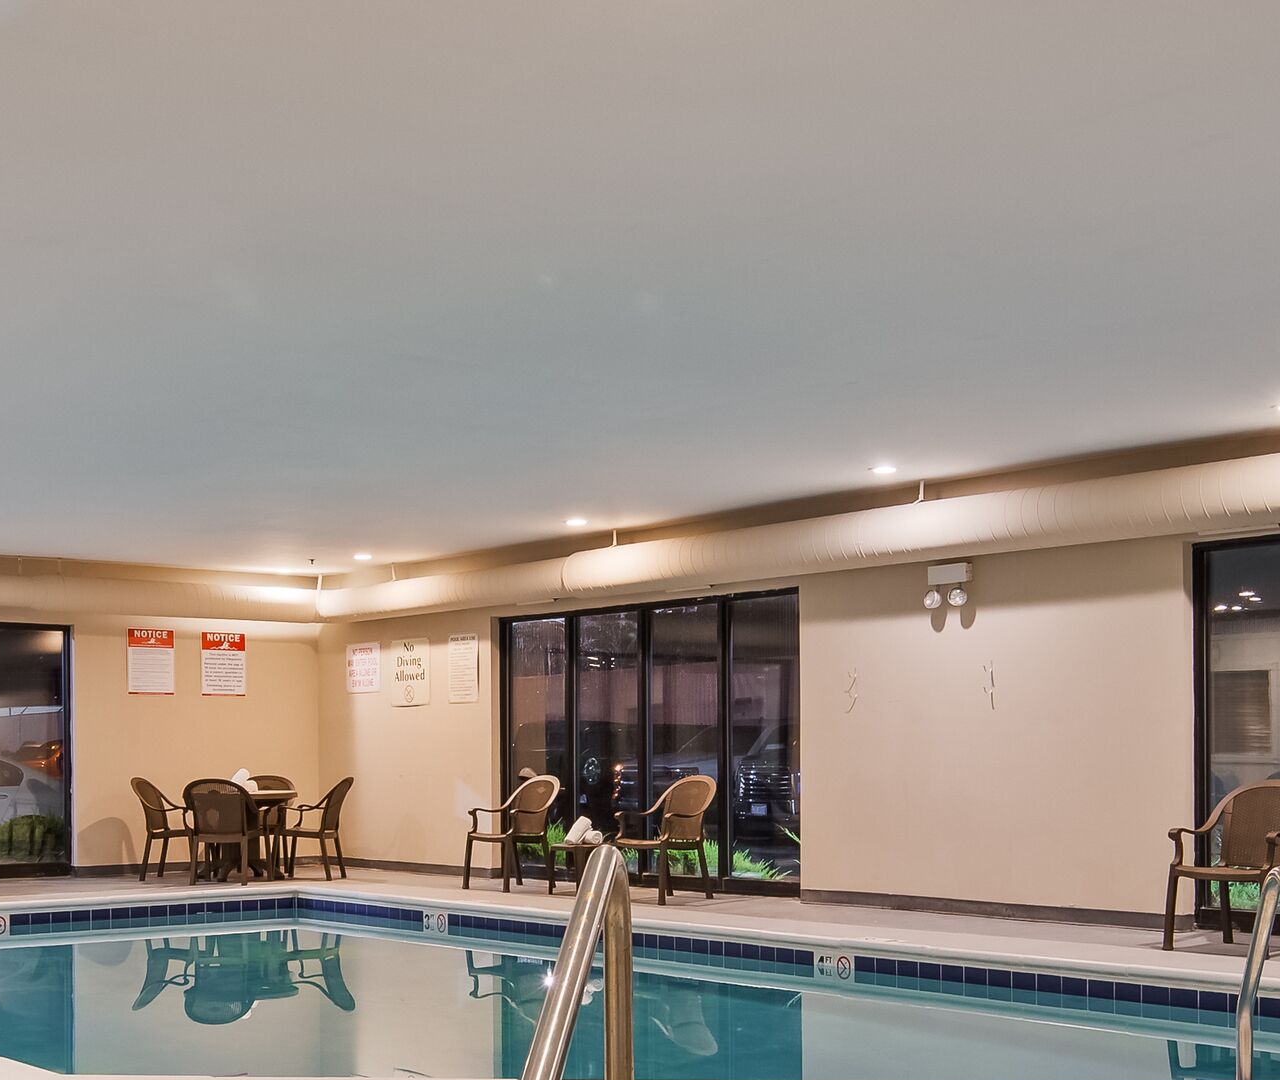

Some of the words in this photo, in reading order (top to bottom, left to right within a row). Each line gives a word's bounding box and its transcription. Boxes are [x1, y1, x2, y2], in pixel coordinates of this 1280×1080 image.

[134, 630, 168, 639] NOTICE
[207, 633, 240, 642] NOTICE
[403, 642, 414, 652] No
[397, 655, 421, 668] Diving
[395, 669, 425, 682] Allowed
